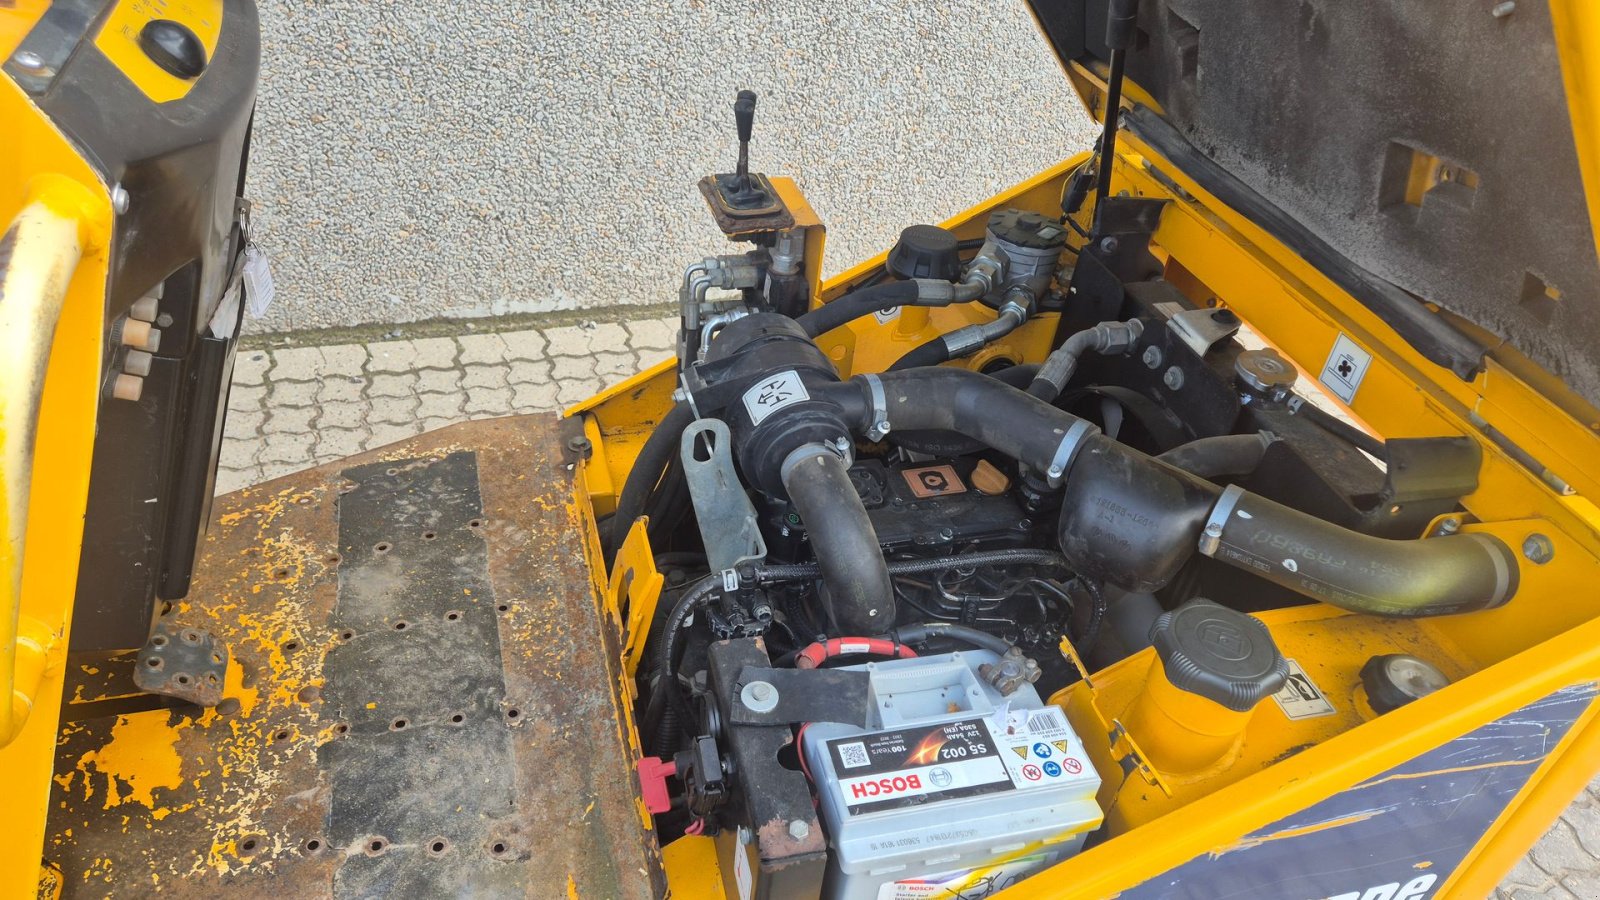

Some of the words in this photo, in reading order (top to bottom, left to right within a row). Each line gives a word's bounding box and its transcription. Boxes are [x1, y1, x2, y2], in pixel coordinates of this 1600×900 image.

[967, 730, 980, 738] 12V
[871, 746, 892, 755] Years
[891, 745, 907, 753] 100
[942, 746, 967, 759] 002
[969, 743, 987, 755] S5
[851, 774, 922, 799] BOSCH
